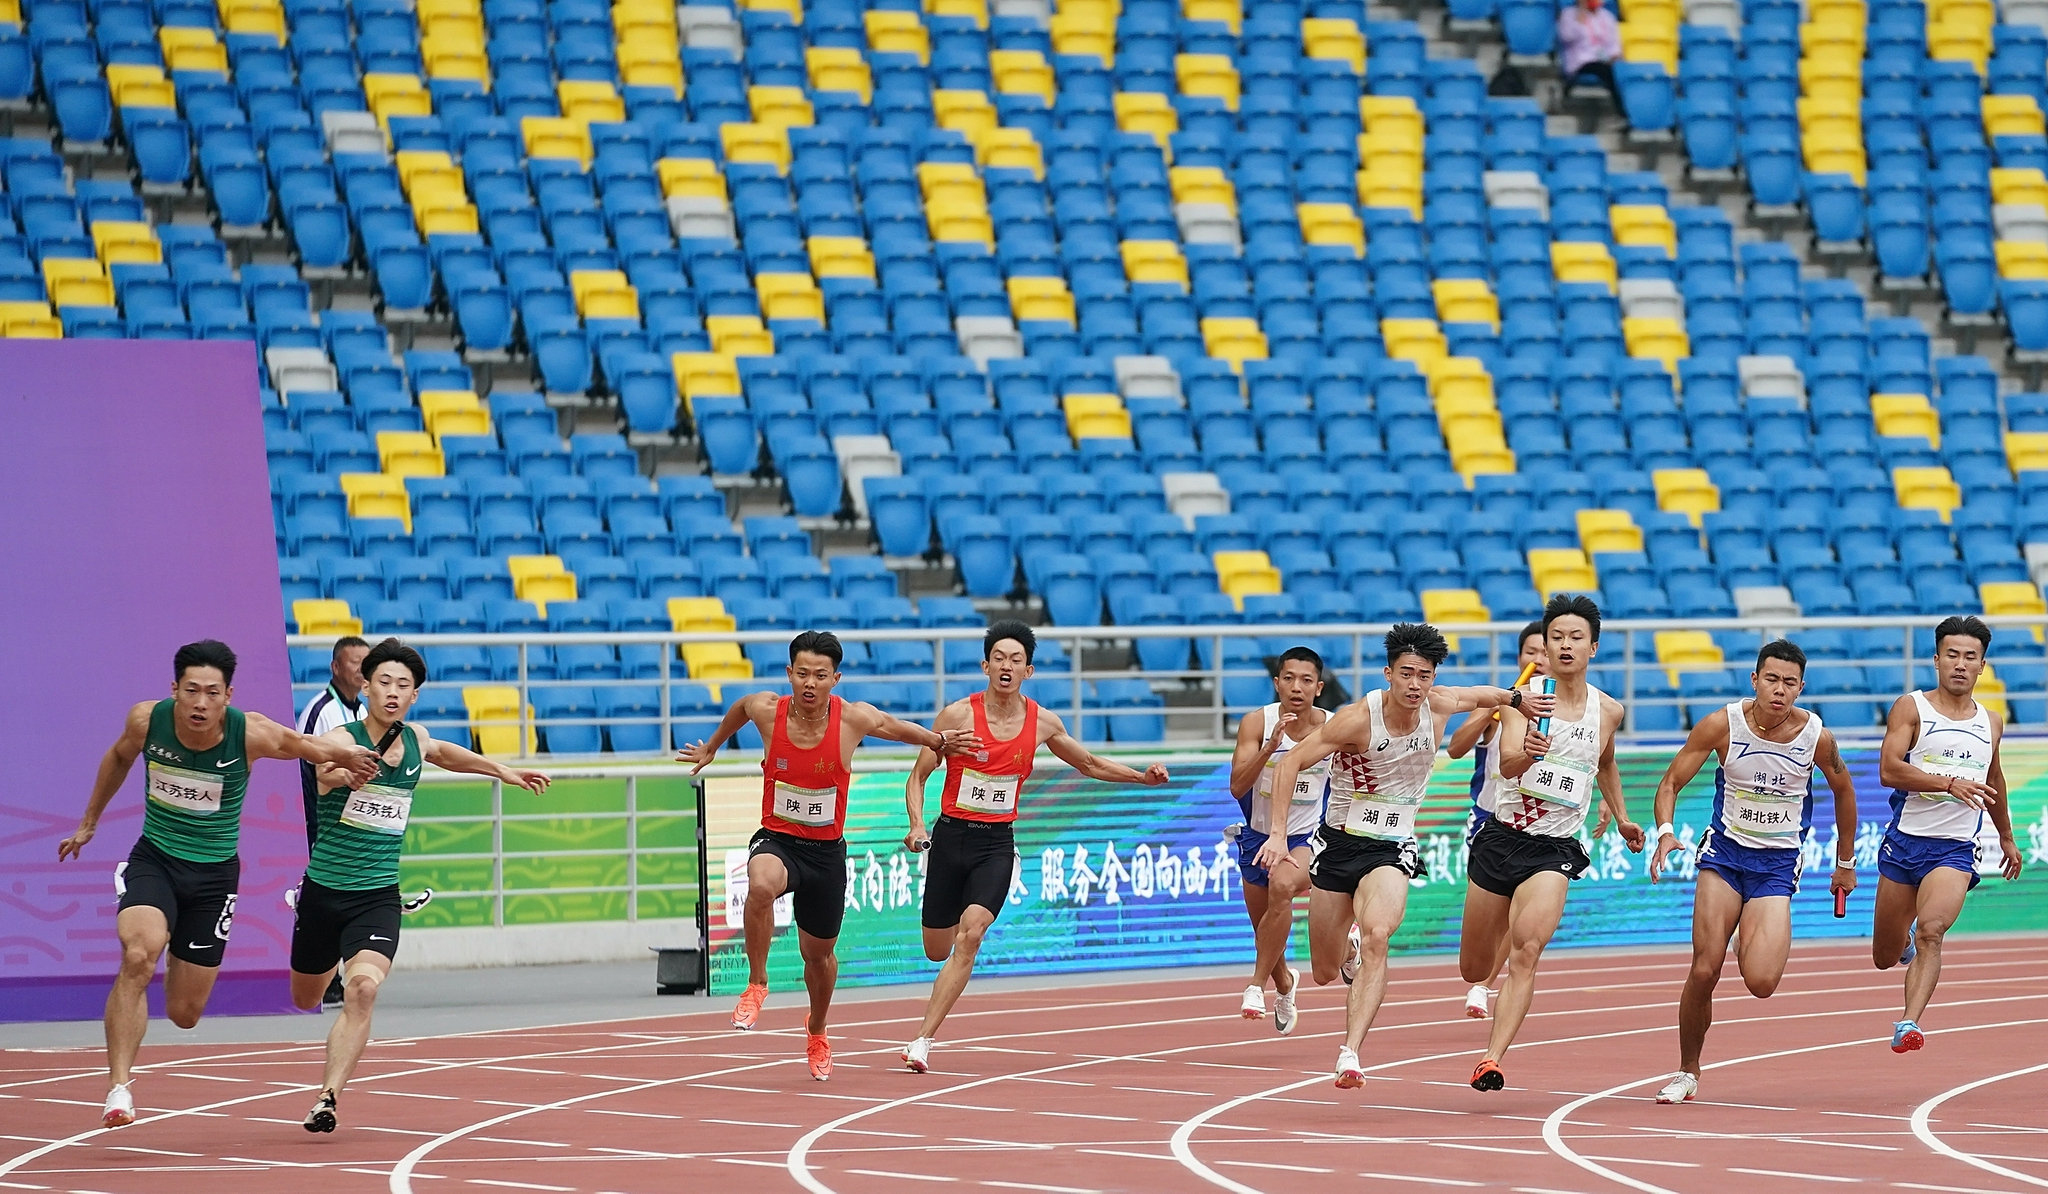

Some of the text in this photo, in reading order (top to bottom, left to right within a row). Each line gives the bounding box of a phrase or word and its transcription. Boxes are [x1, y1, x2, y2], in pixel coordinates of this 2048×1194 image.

[1294, 780, 1310, 795] 南
[1536, 768, 1575, 793] 湖南
[1753, 771, 1787, 786] 湖北
[155, 778, 213, 802] 江苏铁人
[970, 786, 1007, 803] 陕西
[351, 799, 403, 820] 江苏铁人
[786, 798, 823, 816] 陕西
[1739, 806, 1792, 825] 湖北铁人
[1362, 808, 1401, 828] 湖南
[1041, 840, 1244, 906] 服务全国向西开
